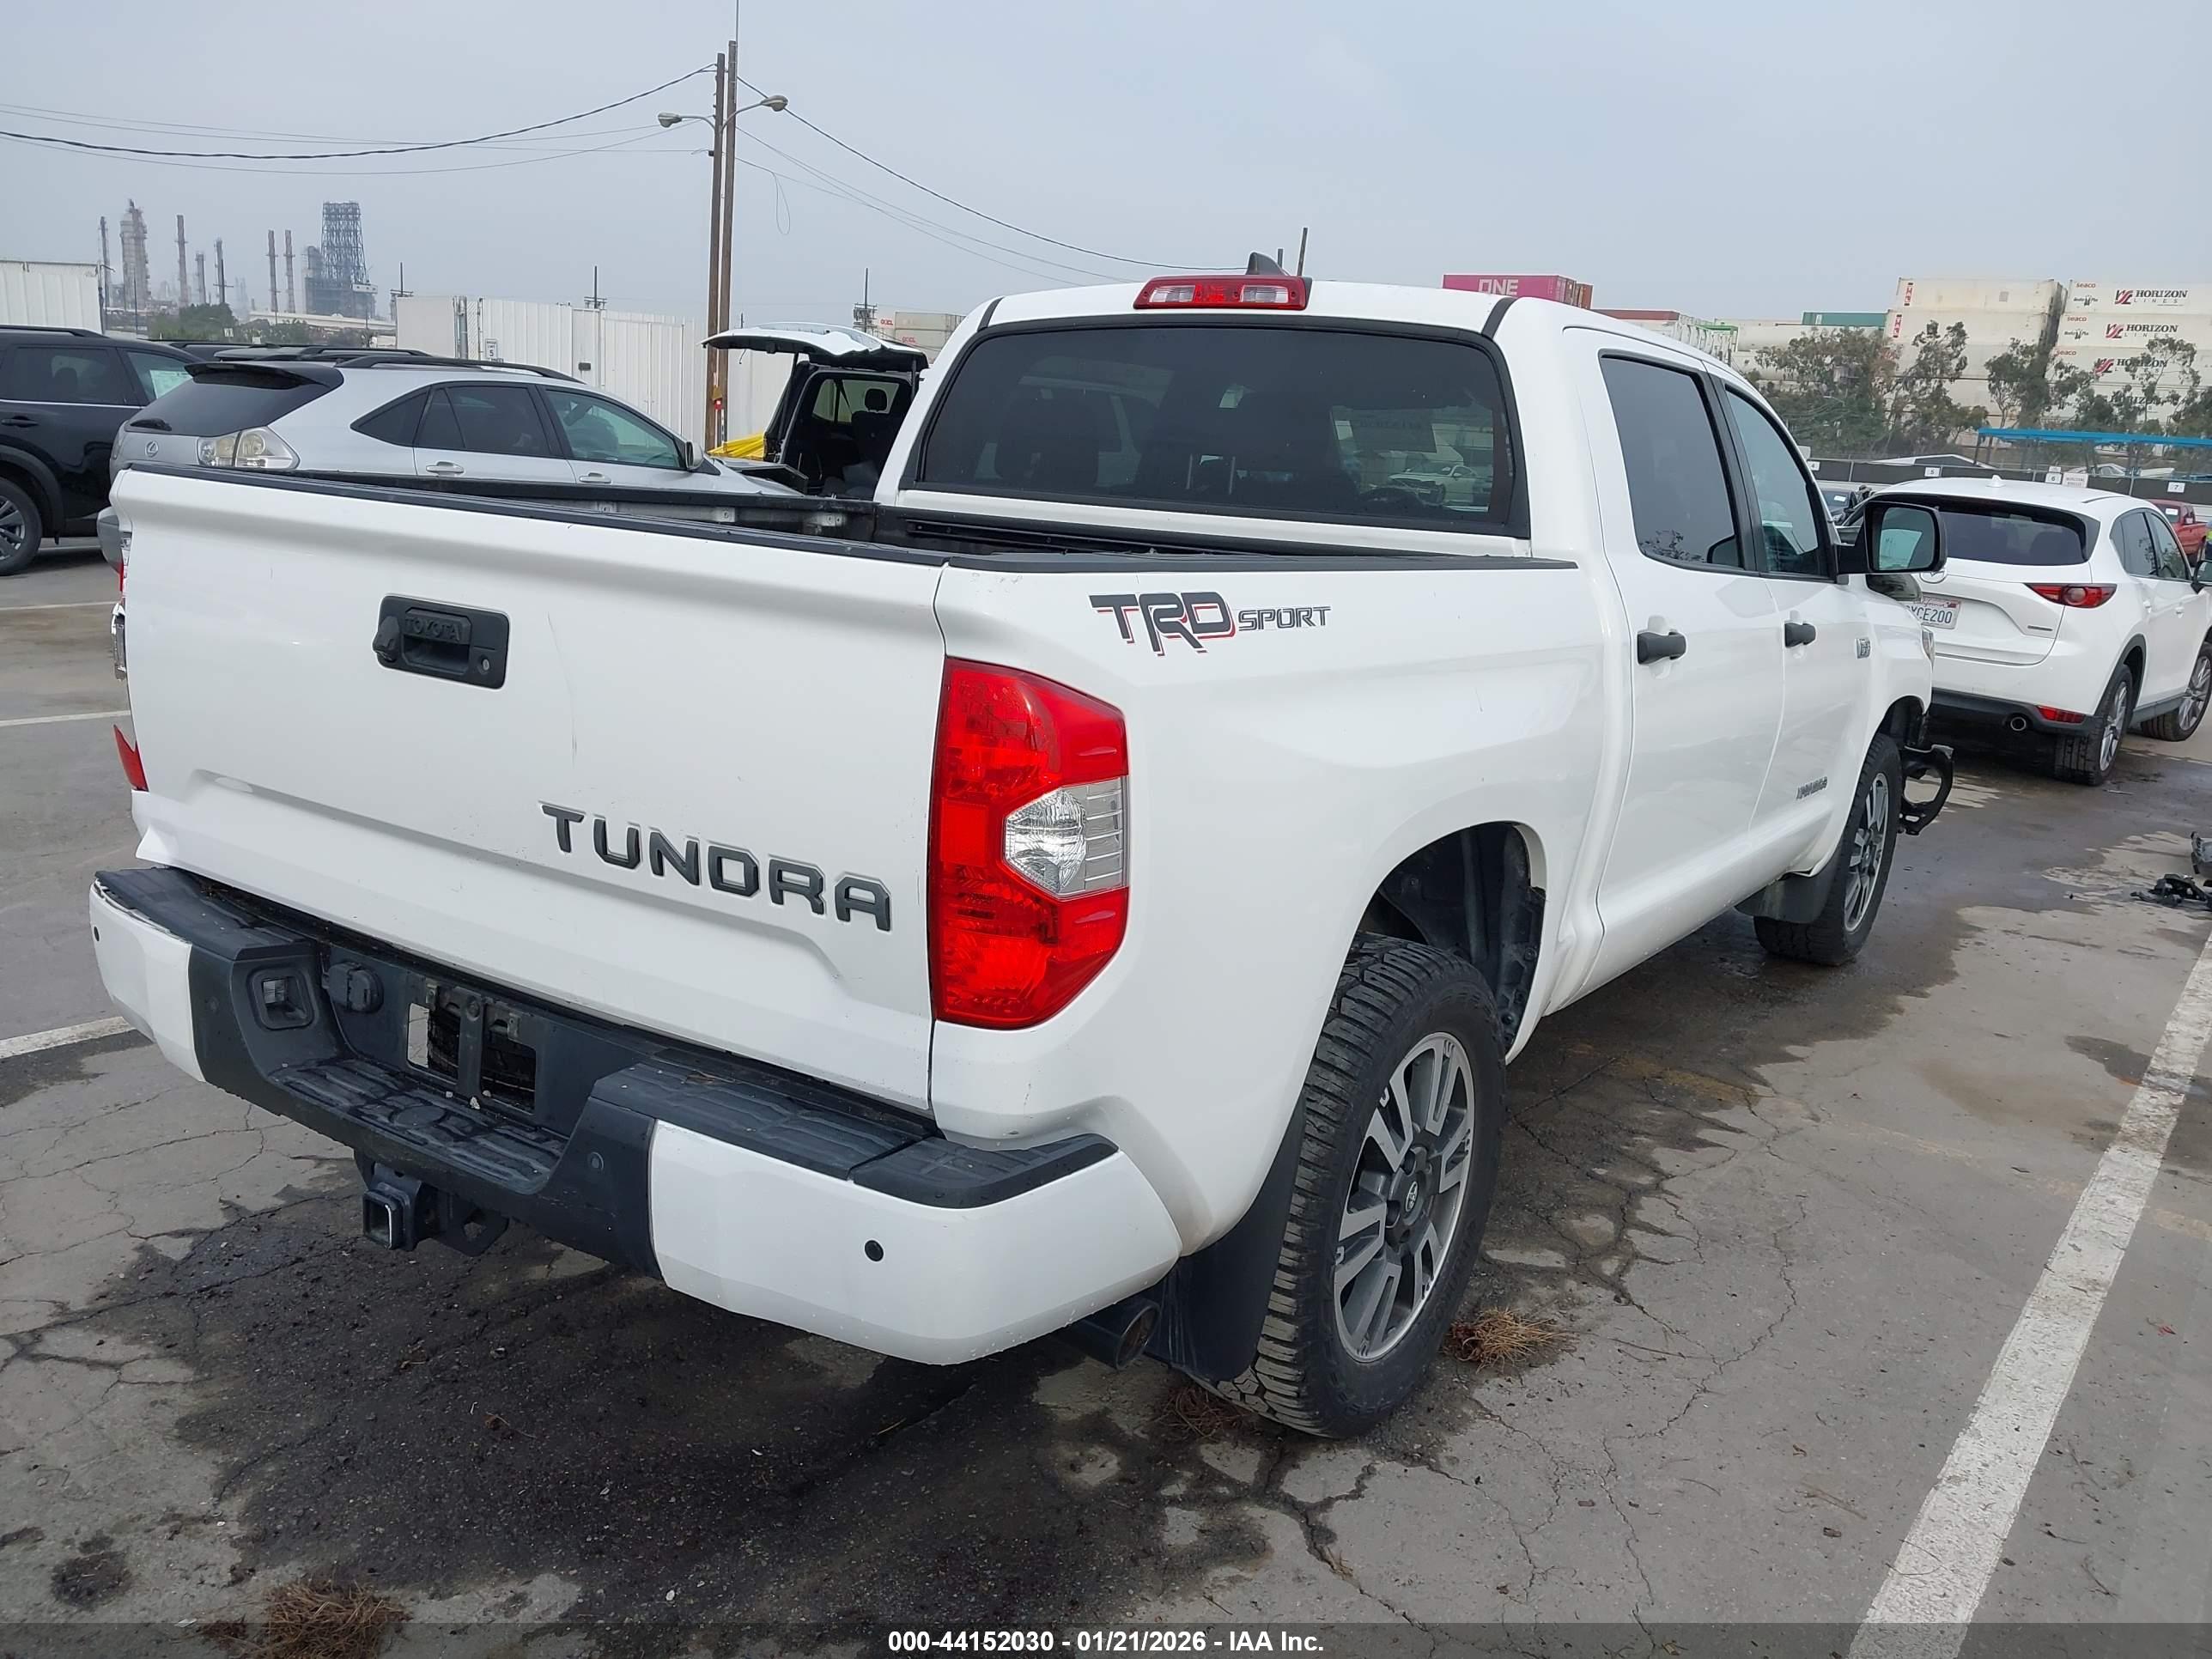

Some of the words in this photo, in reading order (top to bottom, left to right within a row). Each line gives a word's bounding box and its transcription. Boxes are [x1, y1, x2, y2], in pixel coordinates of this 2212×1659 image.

[1478, 278, 1519, 295] ONE
[2135, 289, 2189, 298] HORIZON
[2125, 324, 2179, 333] HORIZON
[2117, 358, 2168, 368] HOIZON
[1906, 605, 1953, 623] CE200
[404, 617, 461, 642] TOYOTA
[1089, 592, 1237, 657] TRD
[1238, 605, 1331, 631] SPORT
[541, 804, 892, 933] TUNDRA
